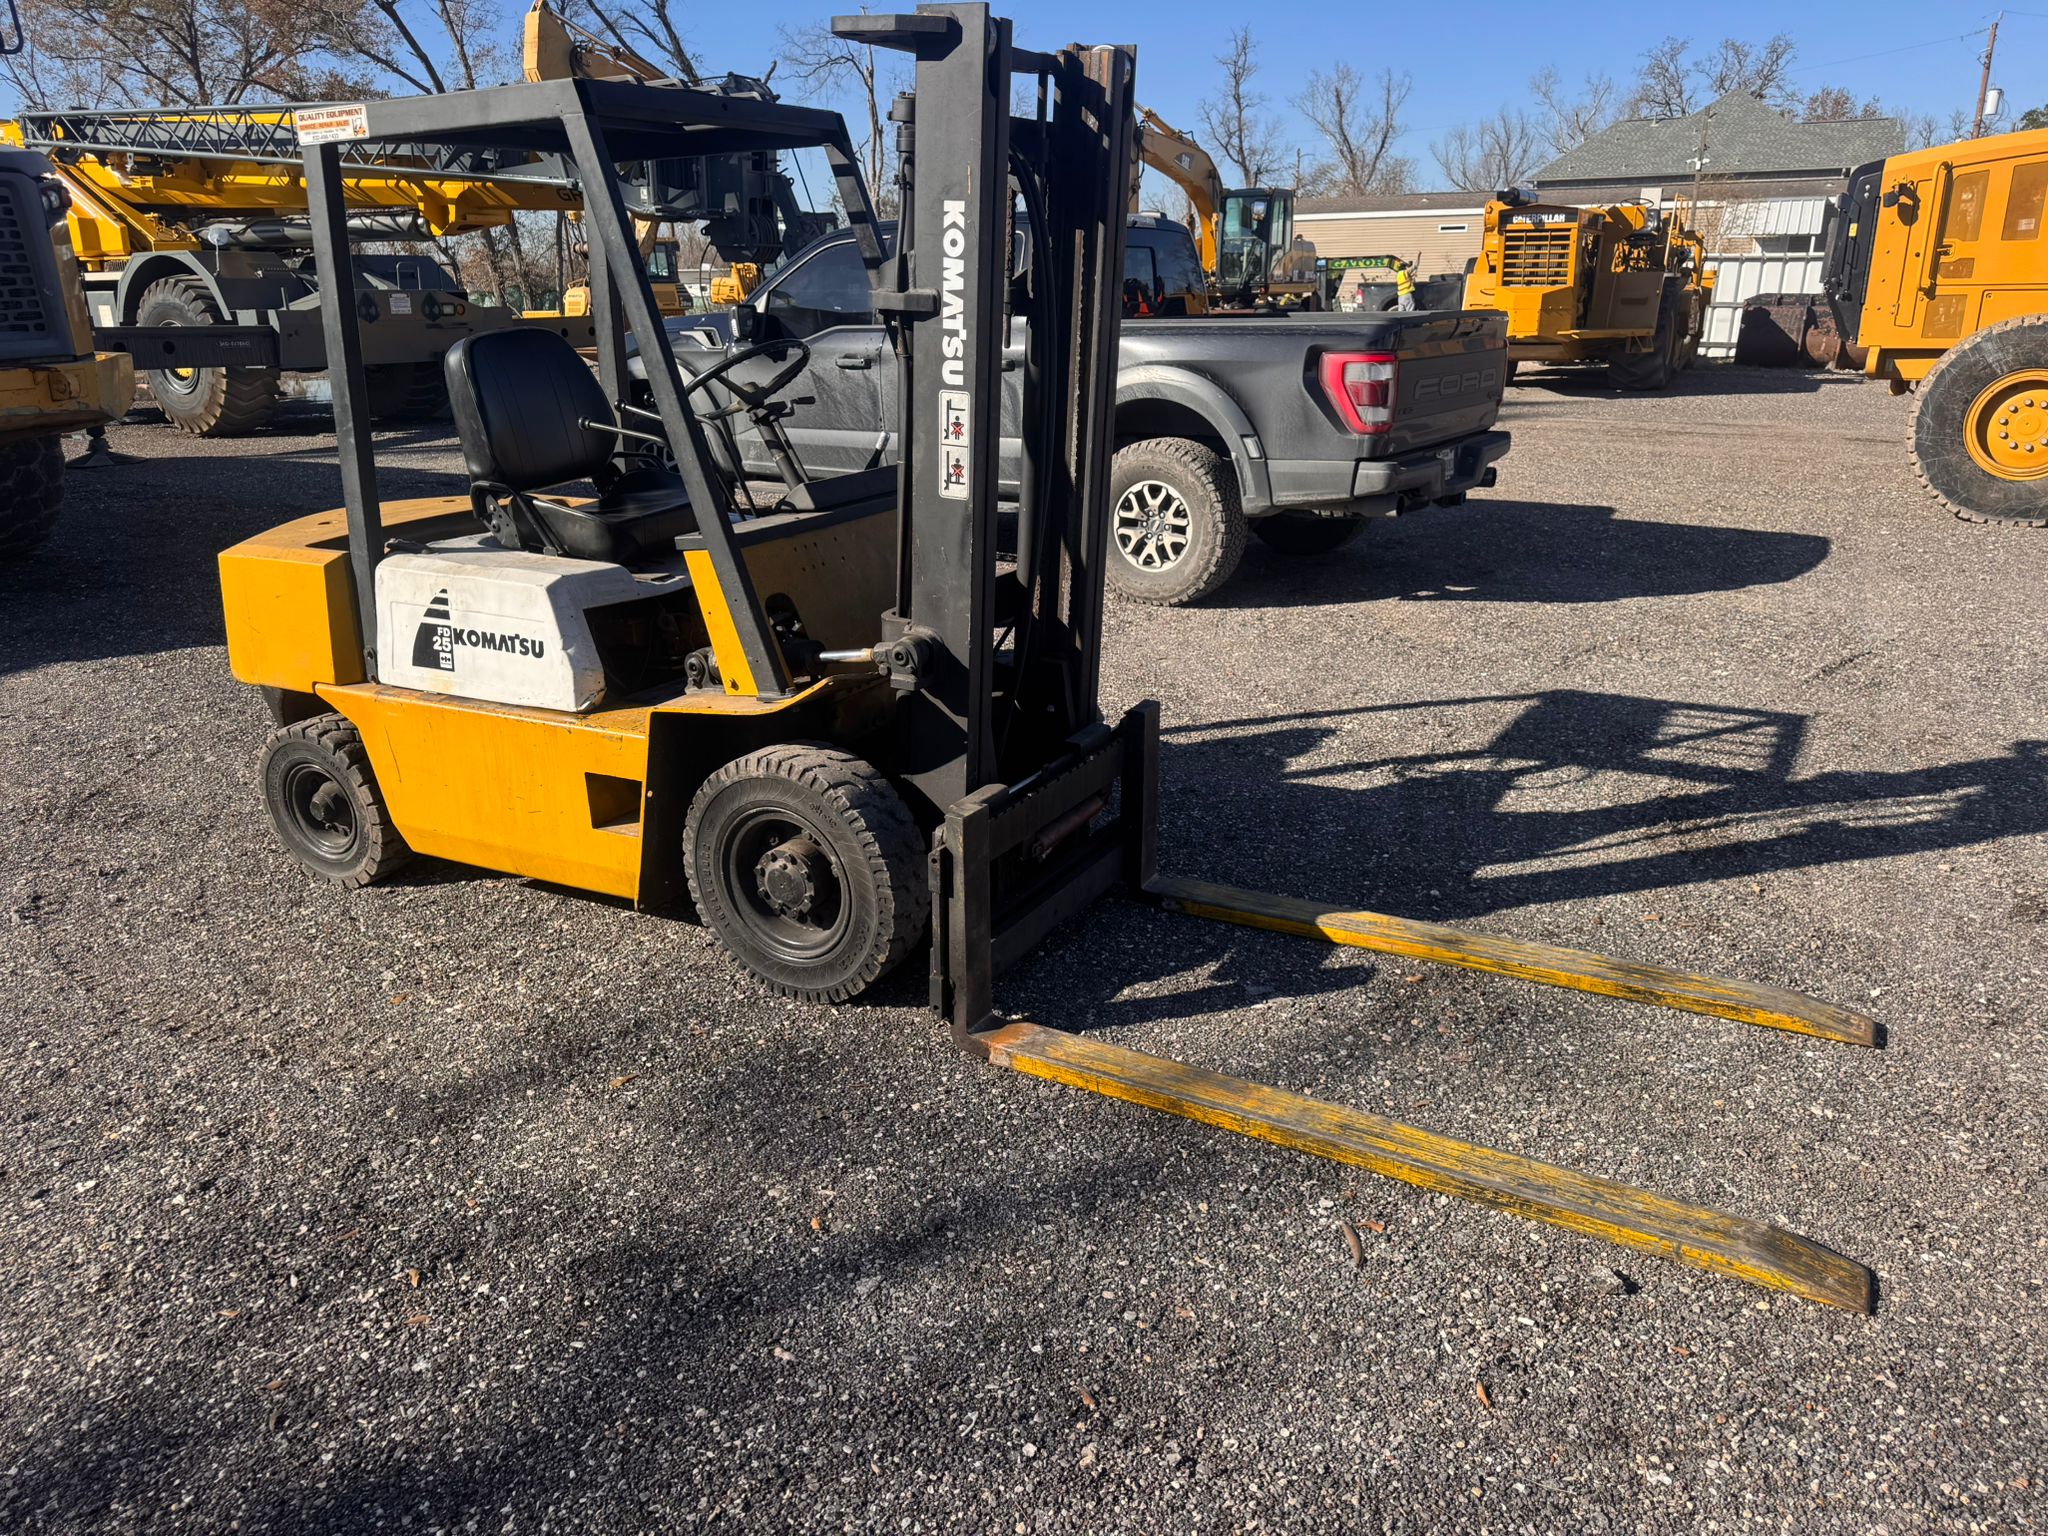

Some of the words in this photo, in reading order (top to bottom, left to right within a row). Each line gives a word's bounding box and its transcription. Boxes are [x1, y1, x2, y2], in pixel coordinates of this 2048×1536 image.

[298, 112, 325, 121] QUALITY
[326, 108, 363, 119] EQUIPMENT
[1512, 213, 1566, 224] CATERPILLAR
[942, 200, 967, 386] KOMATSU
[1414, 368, 1497, 400] FORD
[437, 626, 450, 636] FD
[432, 636, 452, 652] 25
[453, 627, 545, 659] KOMATSU
